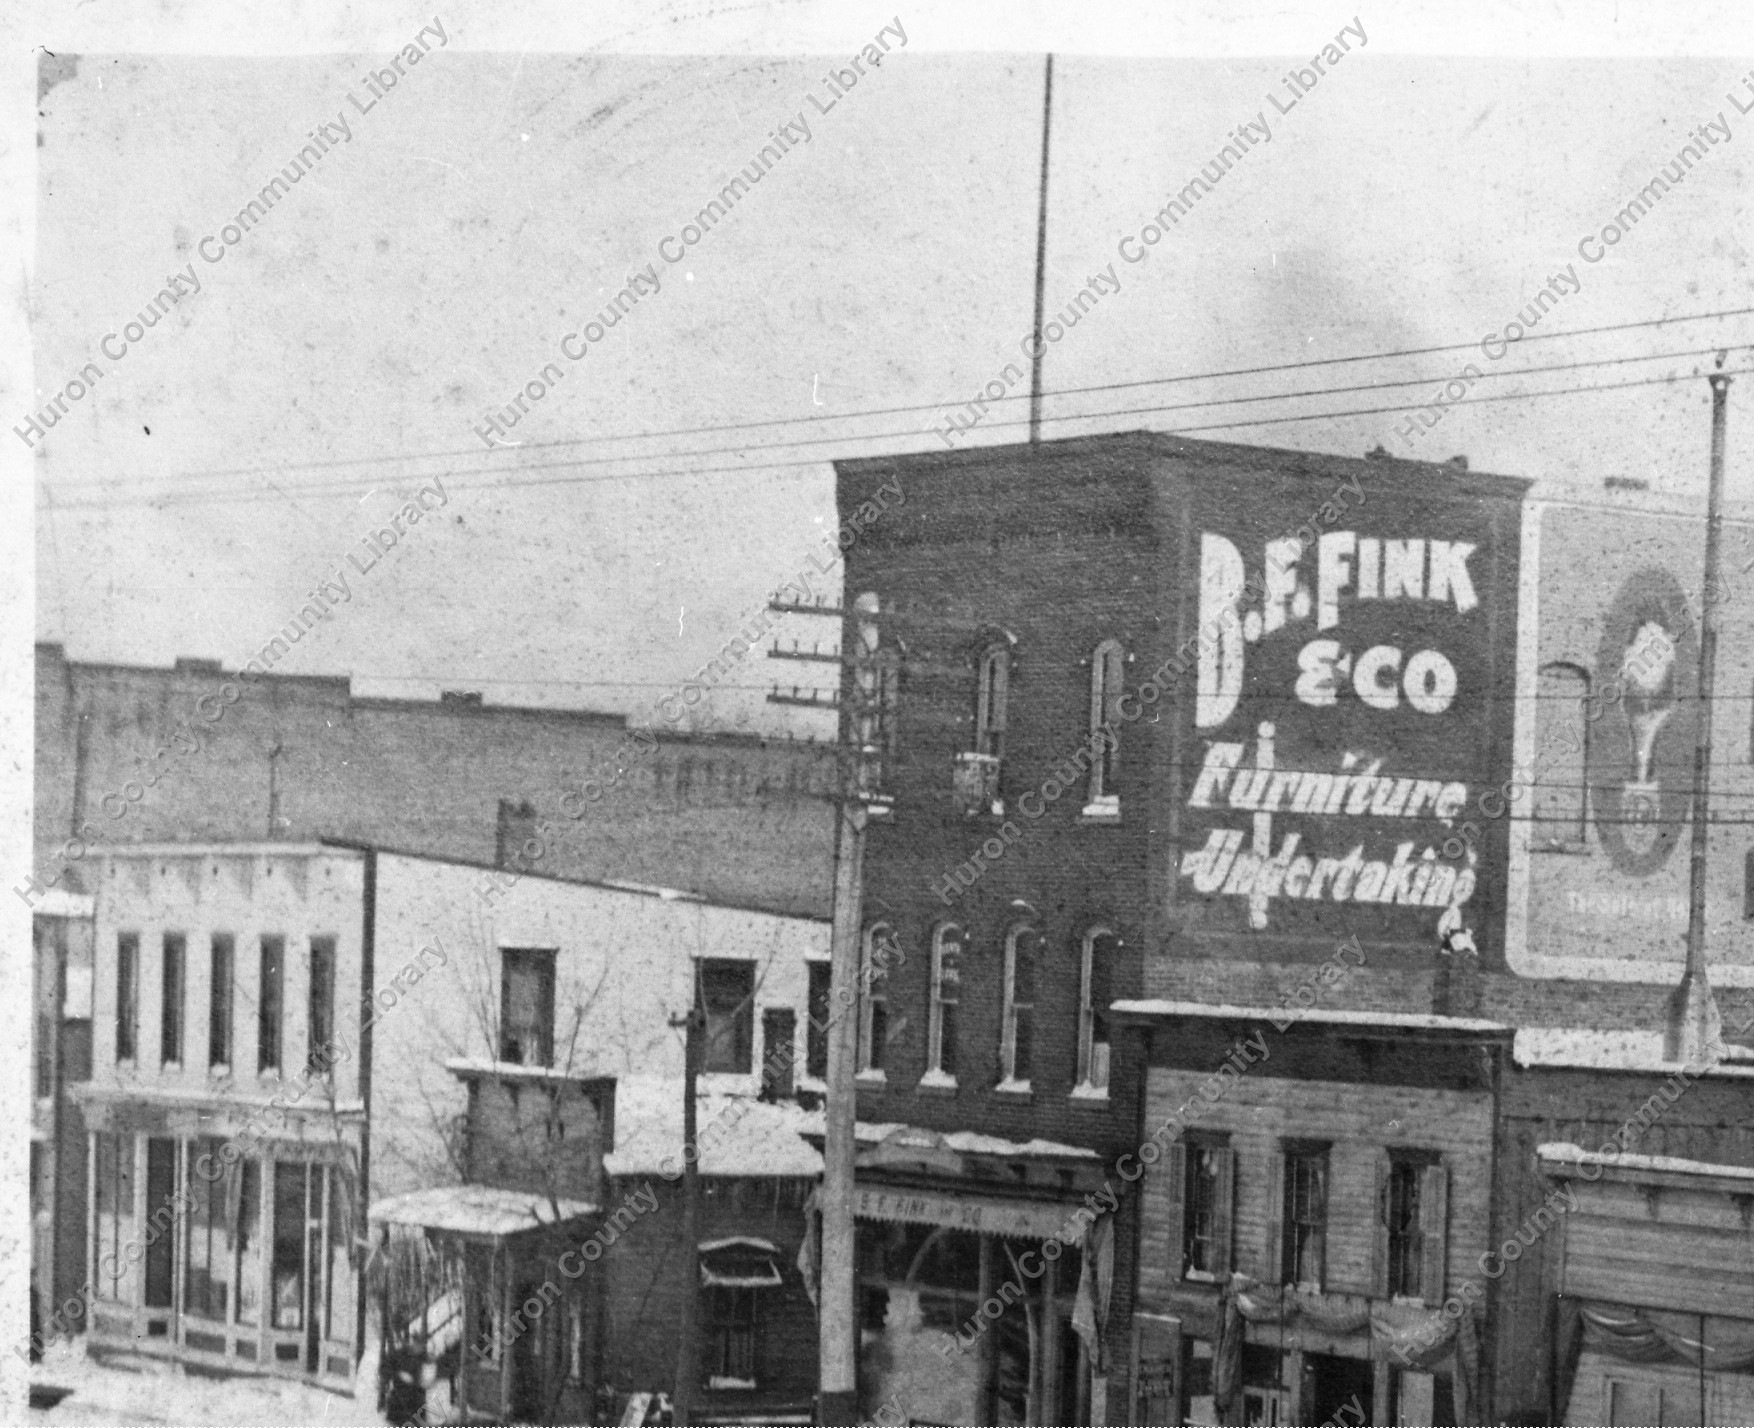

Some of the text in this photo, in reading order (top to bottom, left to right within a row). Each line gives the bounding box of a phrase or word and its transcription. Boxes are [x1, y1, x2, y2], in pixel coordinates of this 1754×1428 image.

[1317, 530, 1479, 628] FINK
[1188, 740, 1468, 824] Furniture
[1180, 828, 1478, 948] Undertaking
